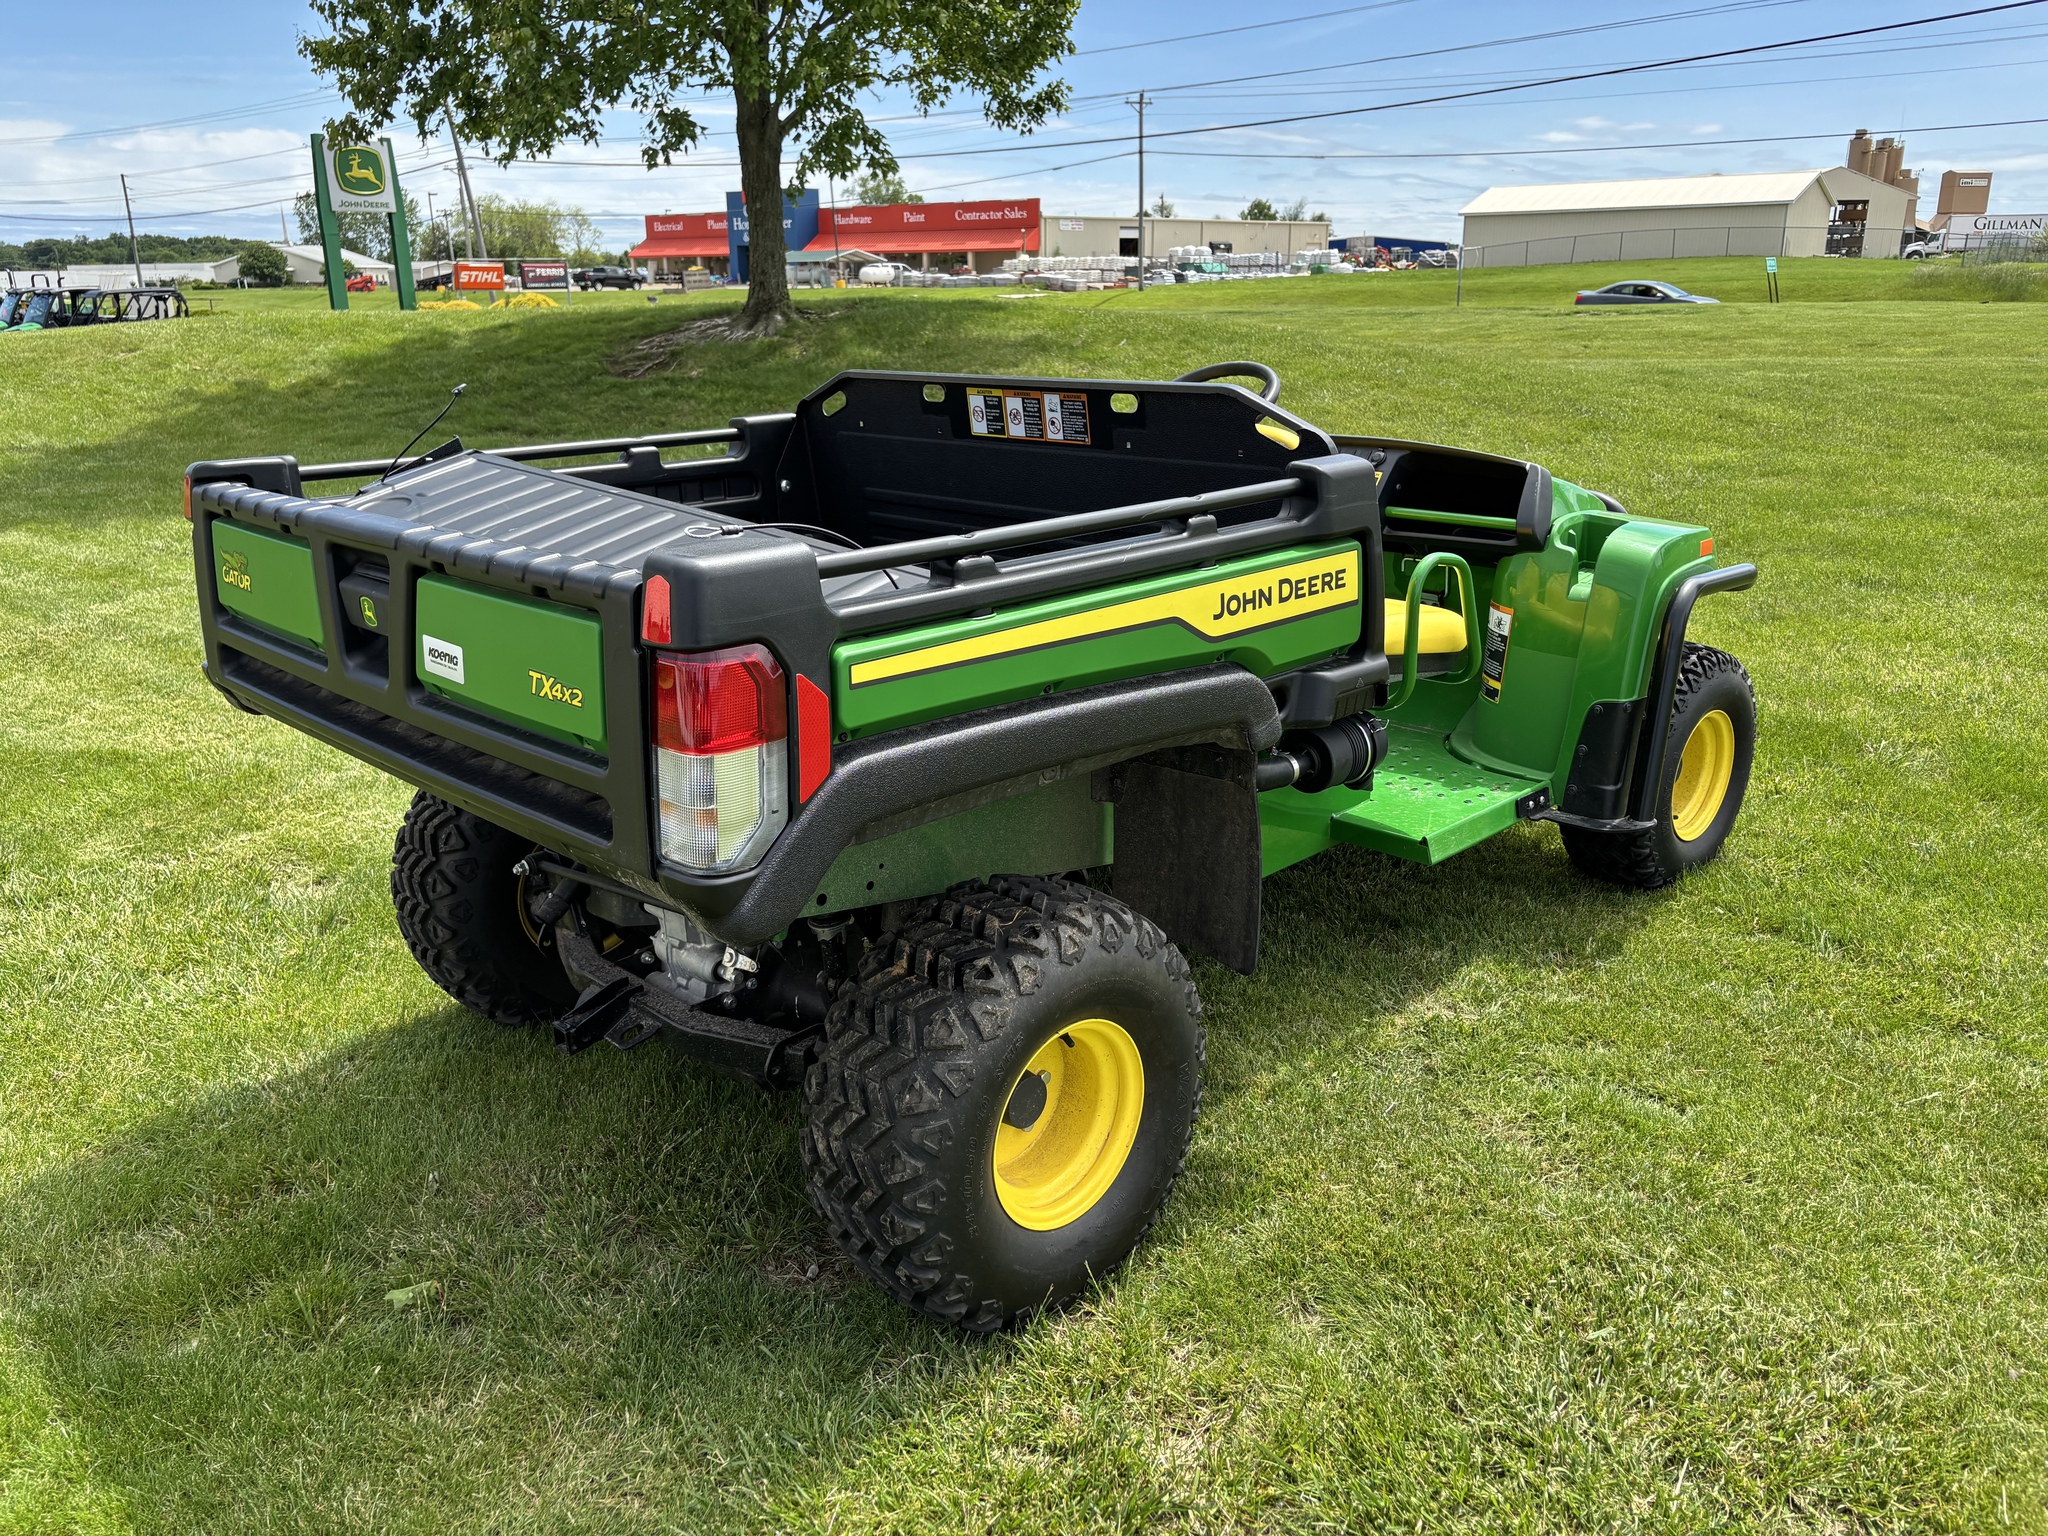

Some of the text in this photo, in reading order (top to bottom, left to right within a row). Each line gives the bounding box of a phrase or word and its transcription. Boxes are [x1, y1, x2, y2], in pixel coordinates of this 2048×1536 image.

[338, 199, 390, 209] JOHN DEERE
[834, 213, 872, 226] Hardware
[903, 211, 925, 223] Paint
[954, 206, 1028, 221] Contractor Sales
[653, 221, 683, 232] Electrical
[706, 219, 728, 230] Plumb
[732, 217, 749, 231] Ho
[1973, 216, 2043, 230] GILLMAN
[459, 270, 502, 283] STIHL
[535, 267, 565, 277] FERRIS
[222, 564, 252, 592] GATOR
[1213, 568, 1347, 621] JOHN DEERE
